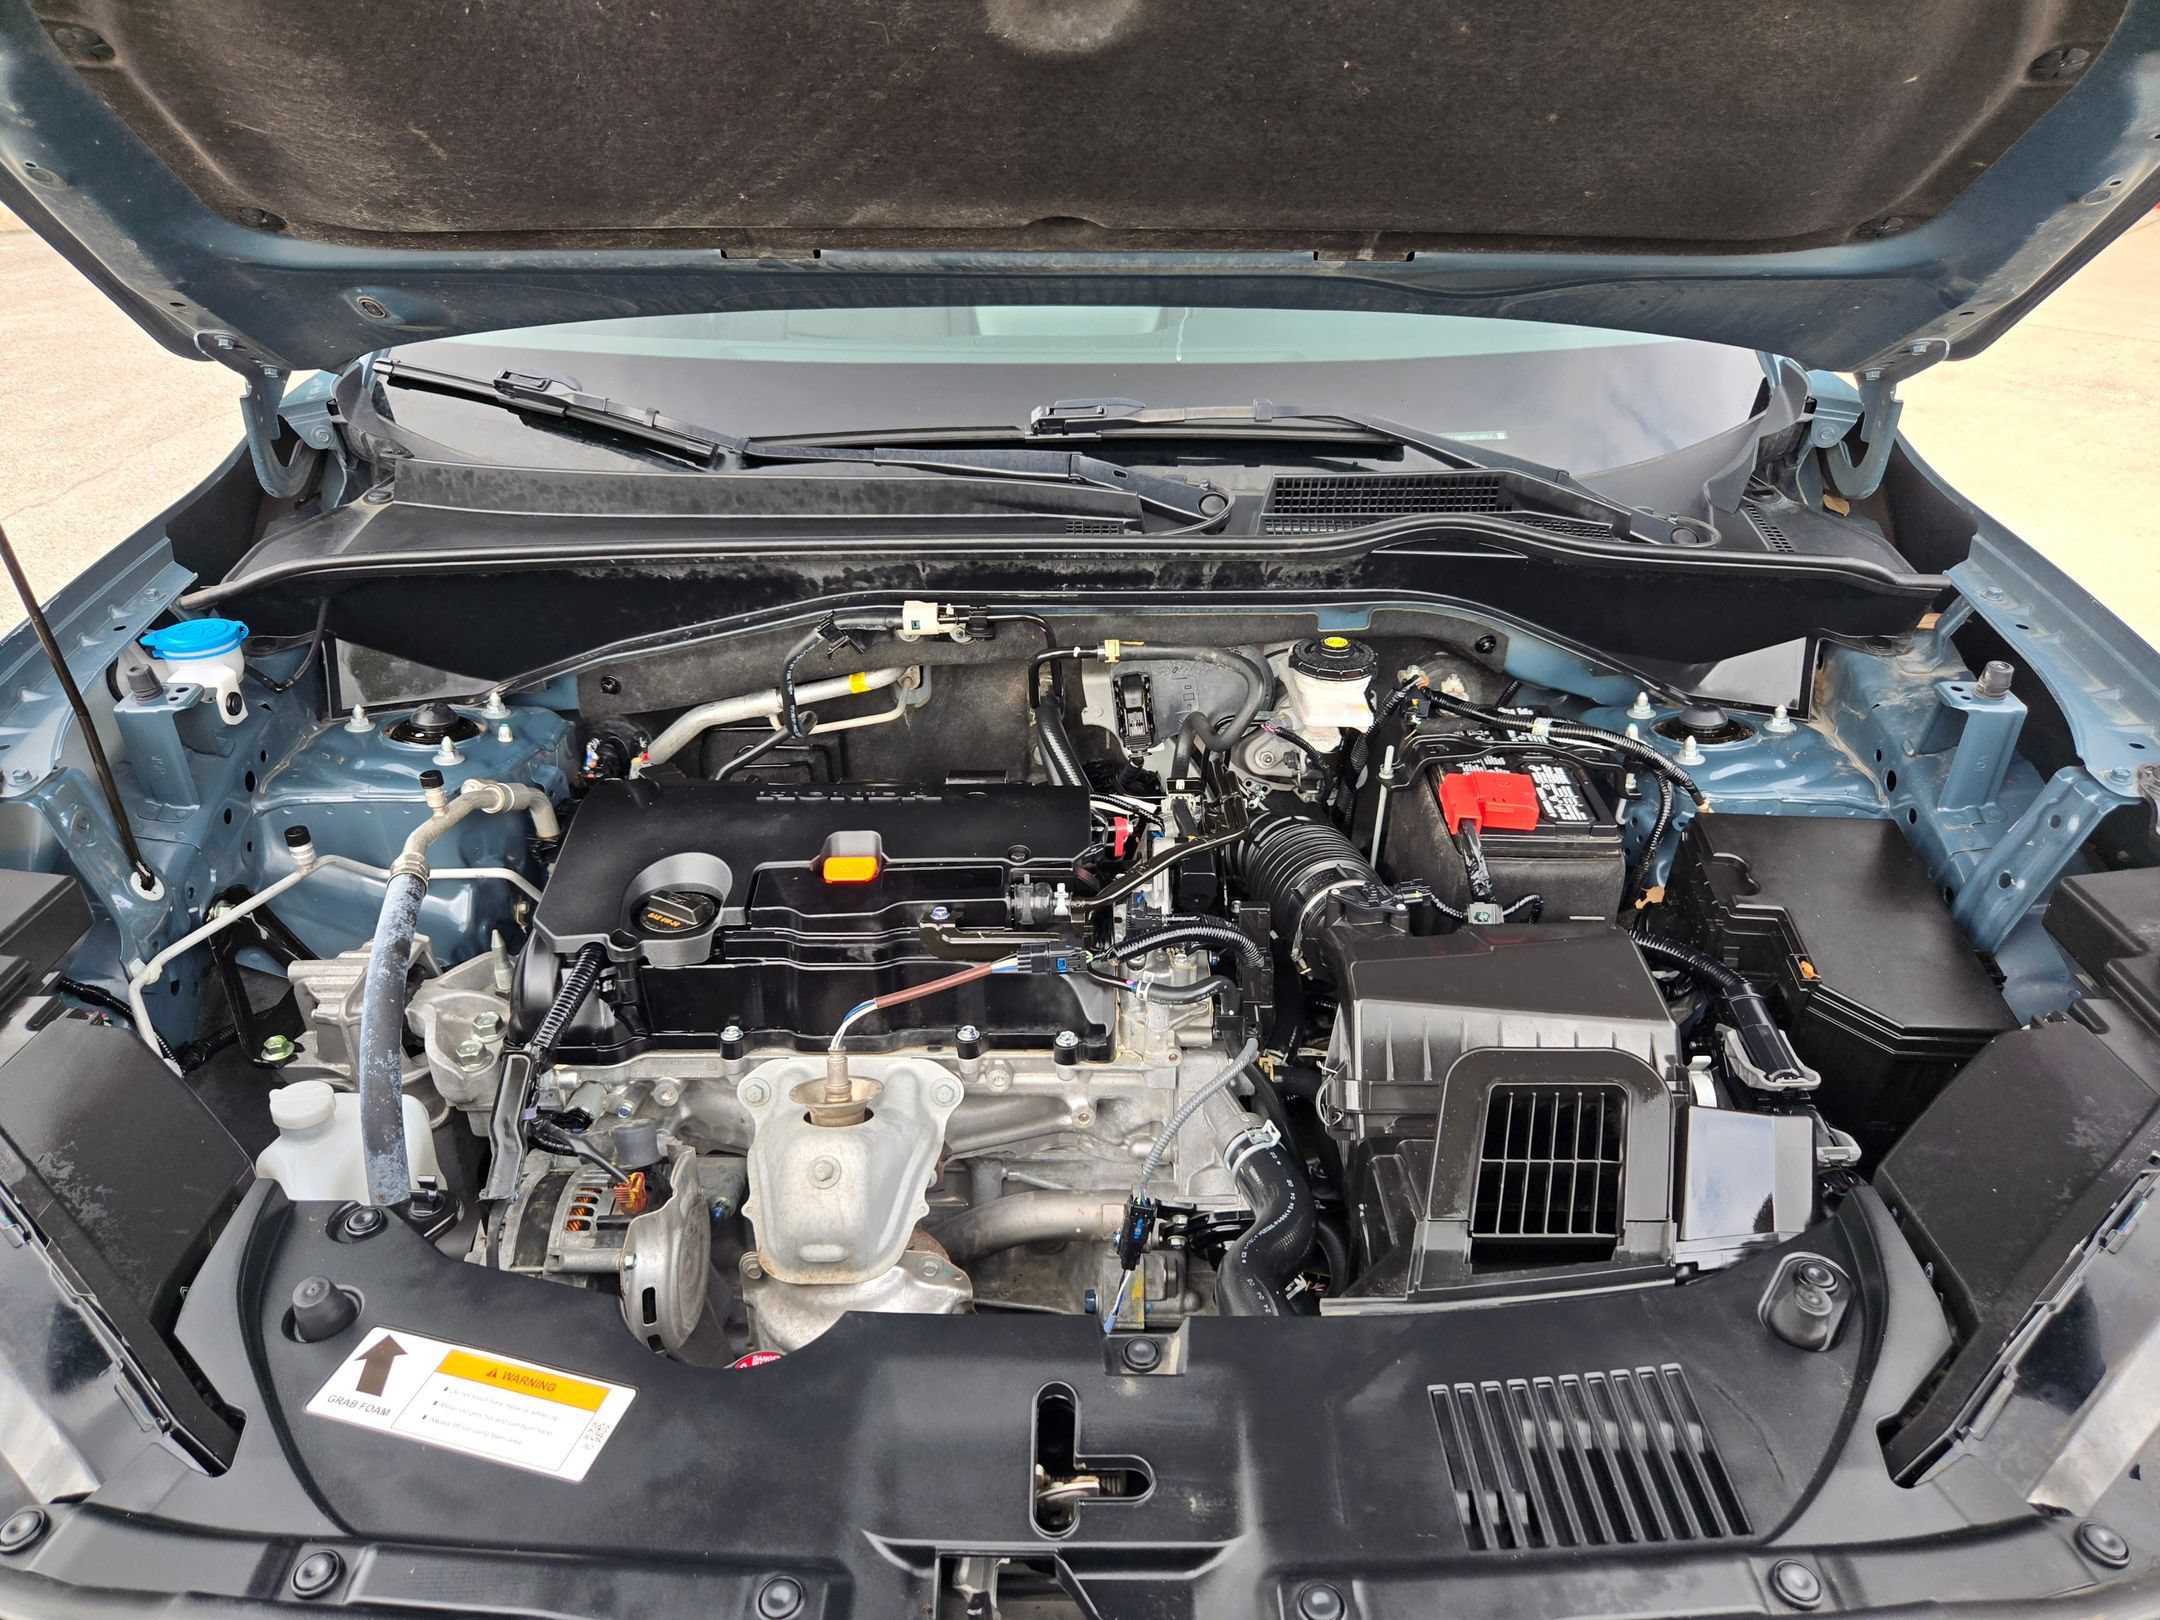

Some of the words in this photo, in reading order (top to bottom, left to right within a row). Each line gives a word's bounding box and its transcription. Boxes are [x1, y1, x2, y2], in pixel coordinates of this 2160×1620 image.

[502, 1370, 557, 1393] WARNING
[327, 1394, 359, 1409] GRAB
[358, 1402, 392, 1417] FOAM
